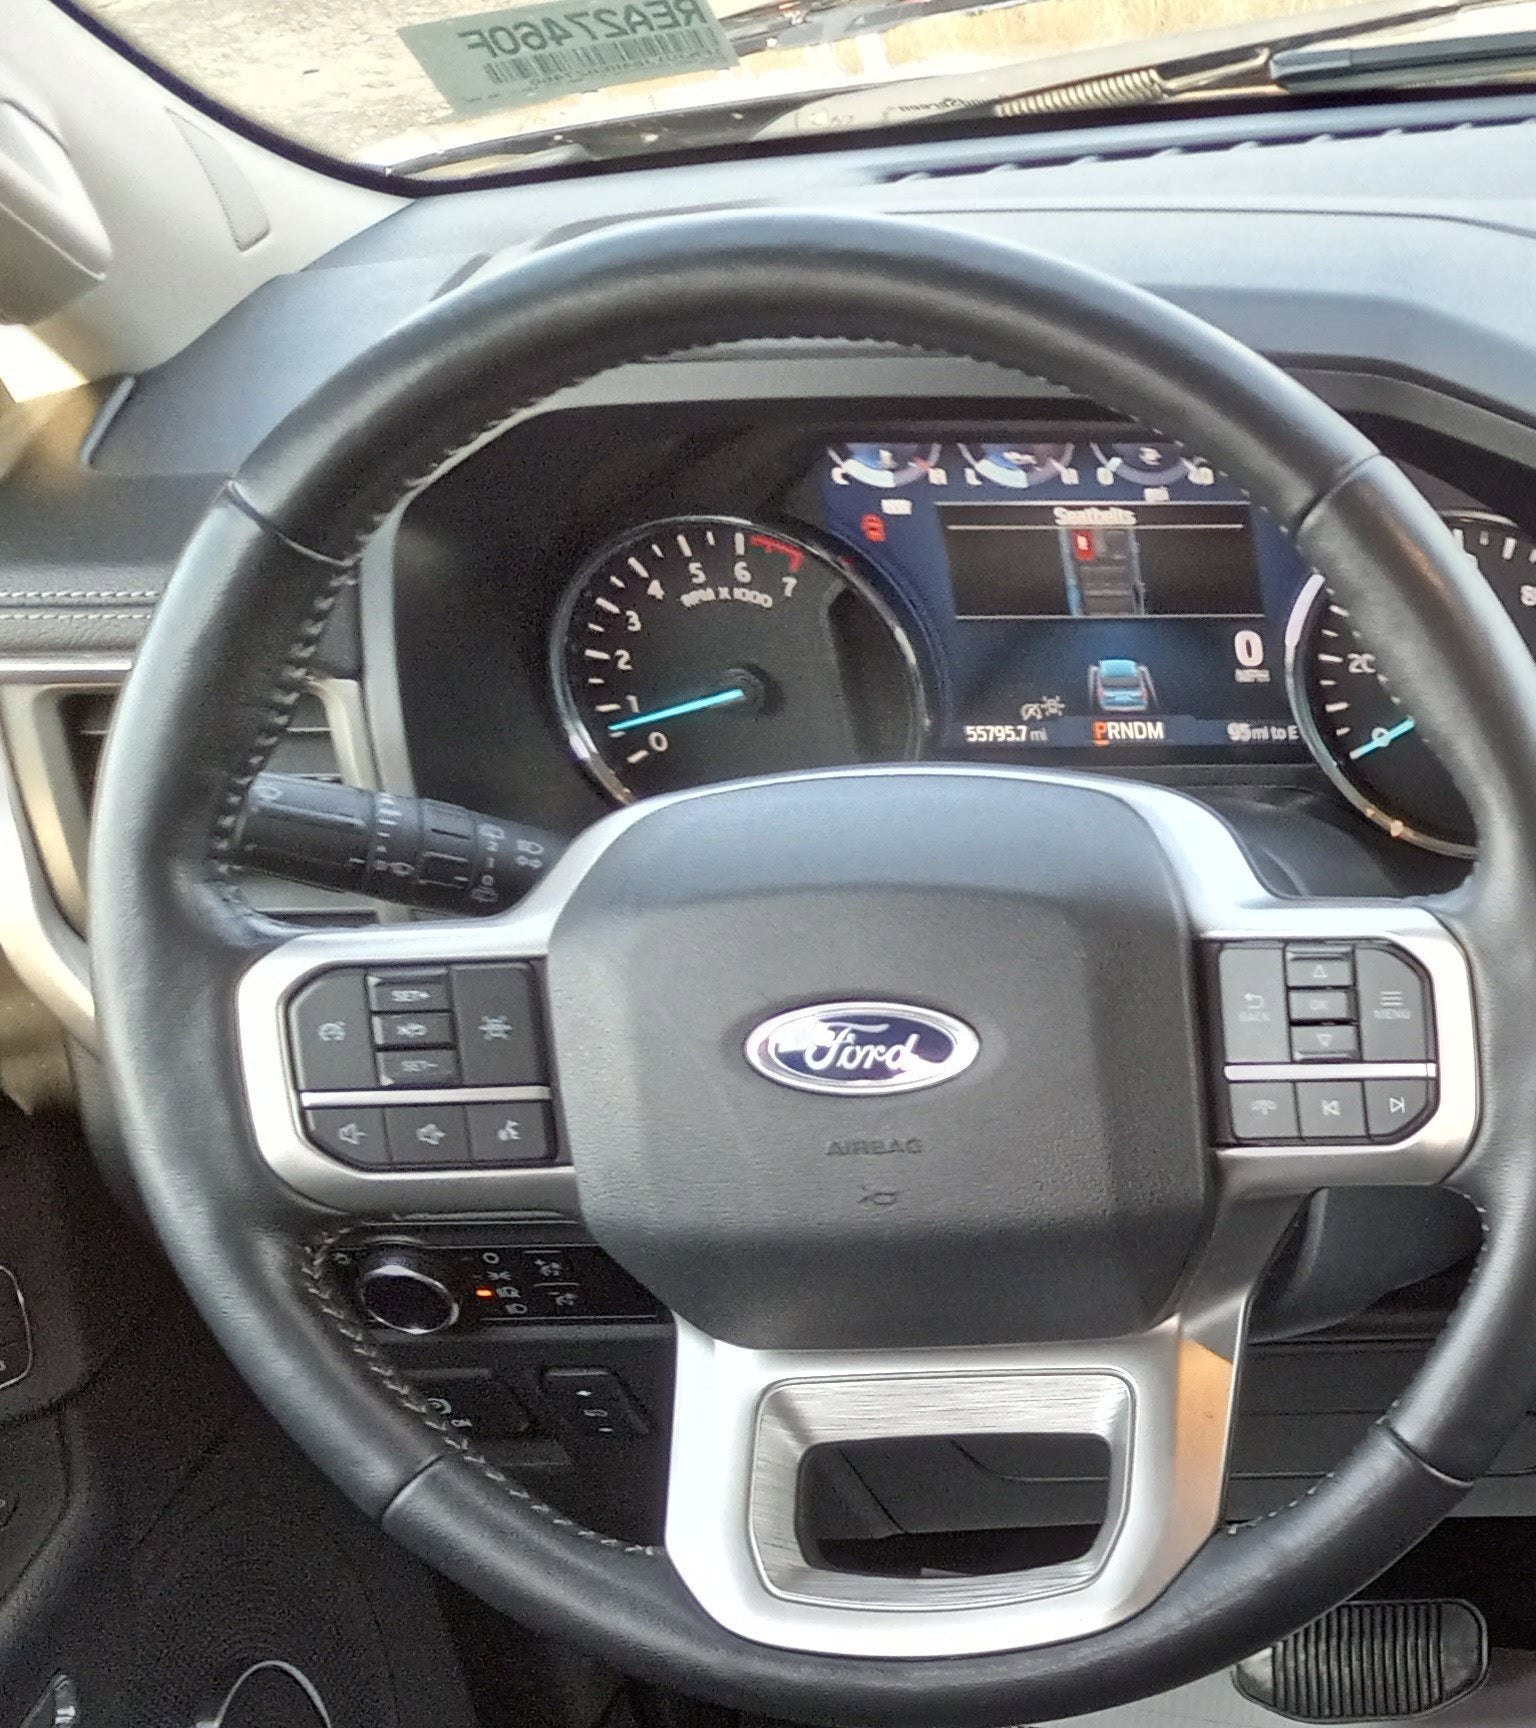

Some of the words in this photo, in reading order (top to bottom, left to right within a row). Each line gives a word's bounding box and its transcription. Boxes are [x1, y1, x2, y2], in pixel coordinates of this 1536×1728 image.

[1053, 507, 1138, 526] Seatbelts
[688, 562, 706, 584] 5
[733, 561, 752, 583] 6
[646, 579, 666, 600] 4
[781, 575, 799, 598] 7
[732, 587, 773, 609] 1000
[625, 610, 642, 632] 3
[614, 649, 633, 671] 2
[1234, 630, 1264, 668] 0
[648, 731, 669, 752] 0
[965, 724, 1028, 742] 55795.7
[825, 1137, 923, 1157] AIRBAG
